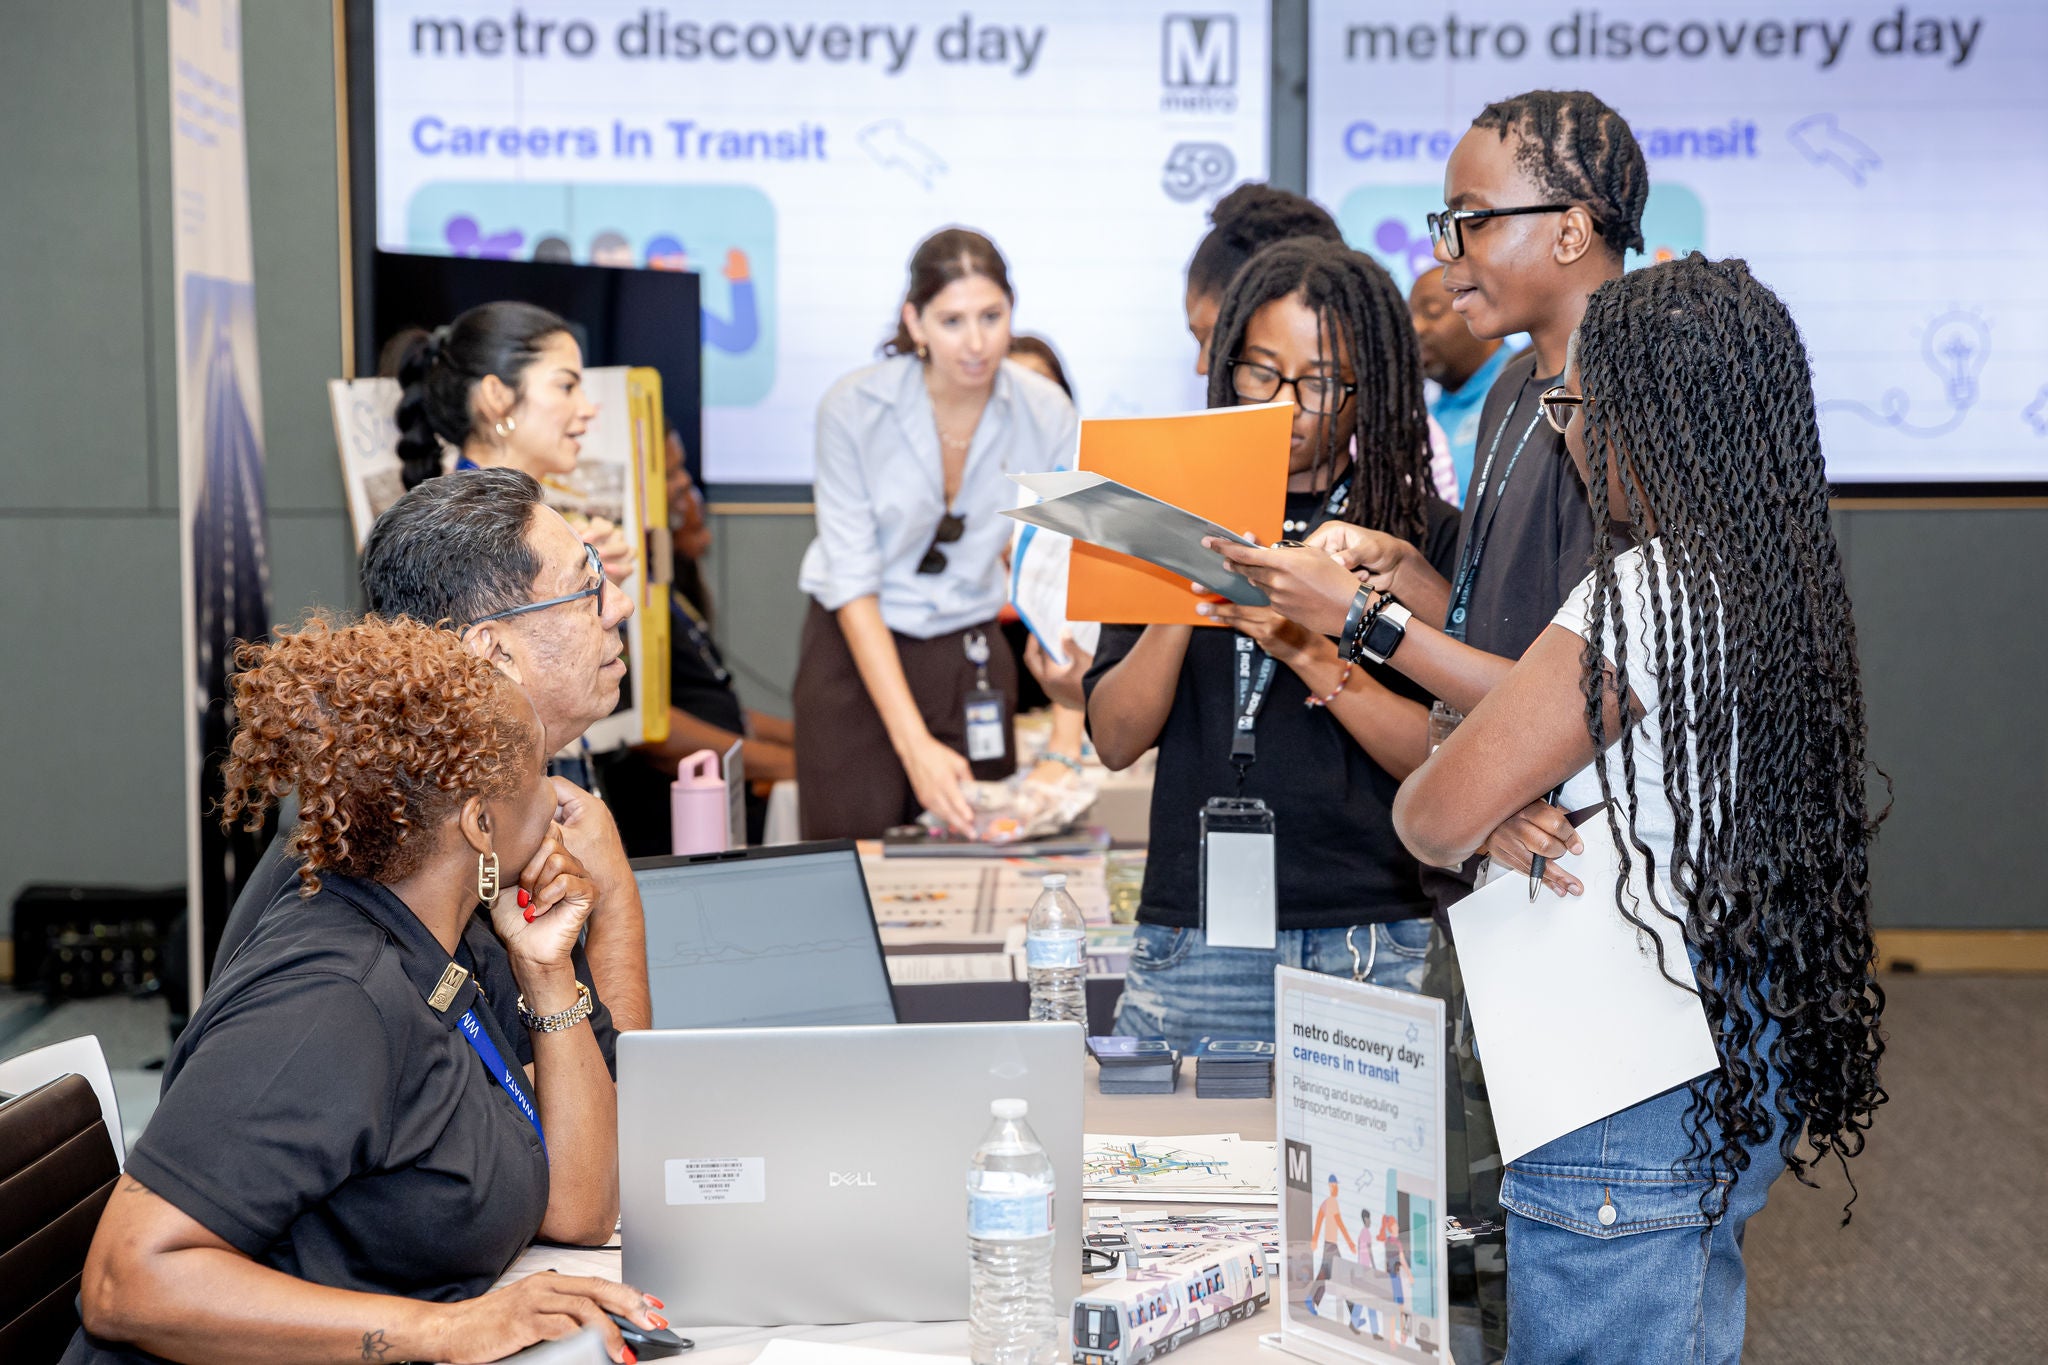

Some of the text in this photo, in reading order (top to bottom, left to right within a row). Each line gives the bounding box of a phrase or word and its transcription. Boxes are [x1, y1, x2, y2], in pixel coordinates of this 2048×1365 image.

[413, 10, 1046, 76] metro discovery day
[1165, 15, 1236, 87] M
[1346, 8, 1981, 69] metro discovery day
[412, 116, 827, 160] Careers In Transit
[1344, 119, 1757, 160] Care ansit
[1162, 142, 1237, 202] 50
[1240, 652, 1250, 677] RIDE
[1245, 692, 1261, 715] RIDE
[1254, 658, 1272, 691] SILVER
[445, 969, 463, 988] M
[1293, 1022, 1425, 1069] metro discovery day:
[1293, 1046, 1400, 1084] careers in transit
[506, 1070, 533, 1120] WMATA
[1293, 1075, 1399, 1119] Planning and scheduling
[1293, 1096, 1387, 1132] transportation service
[829, 1171, 877, 1186] DELL
[1288, 1147, 1307, 1183] M
